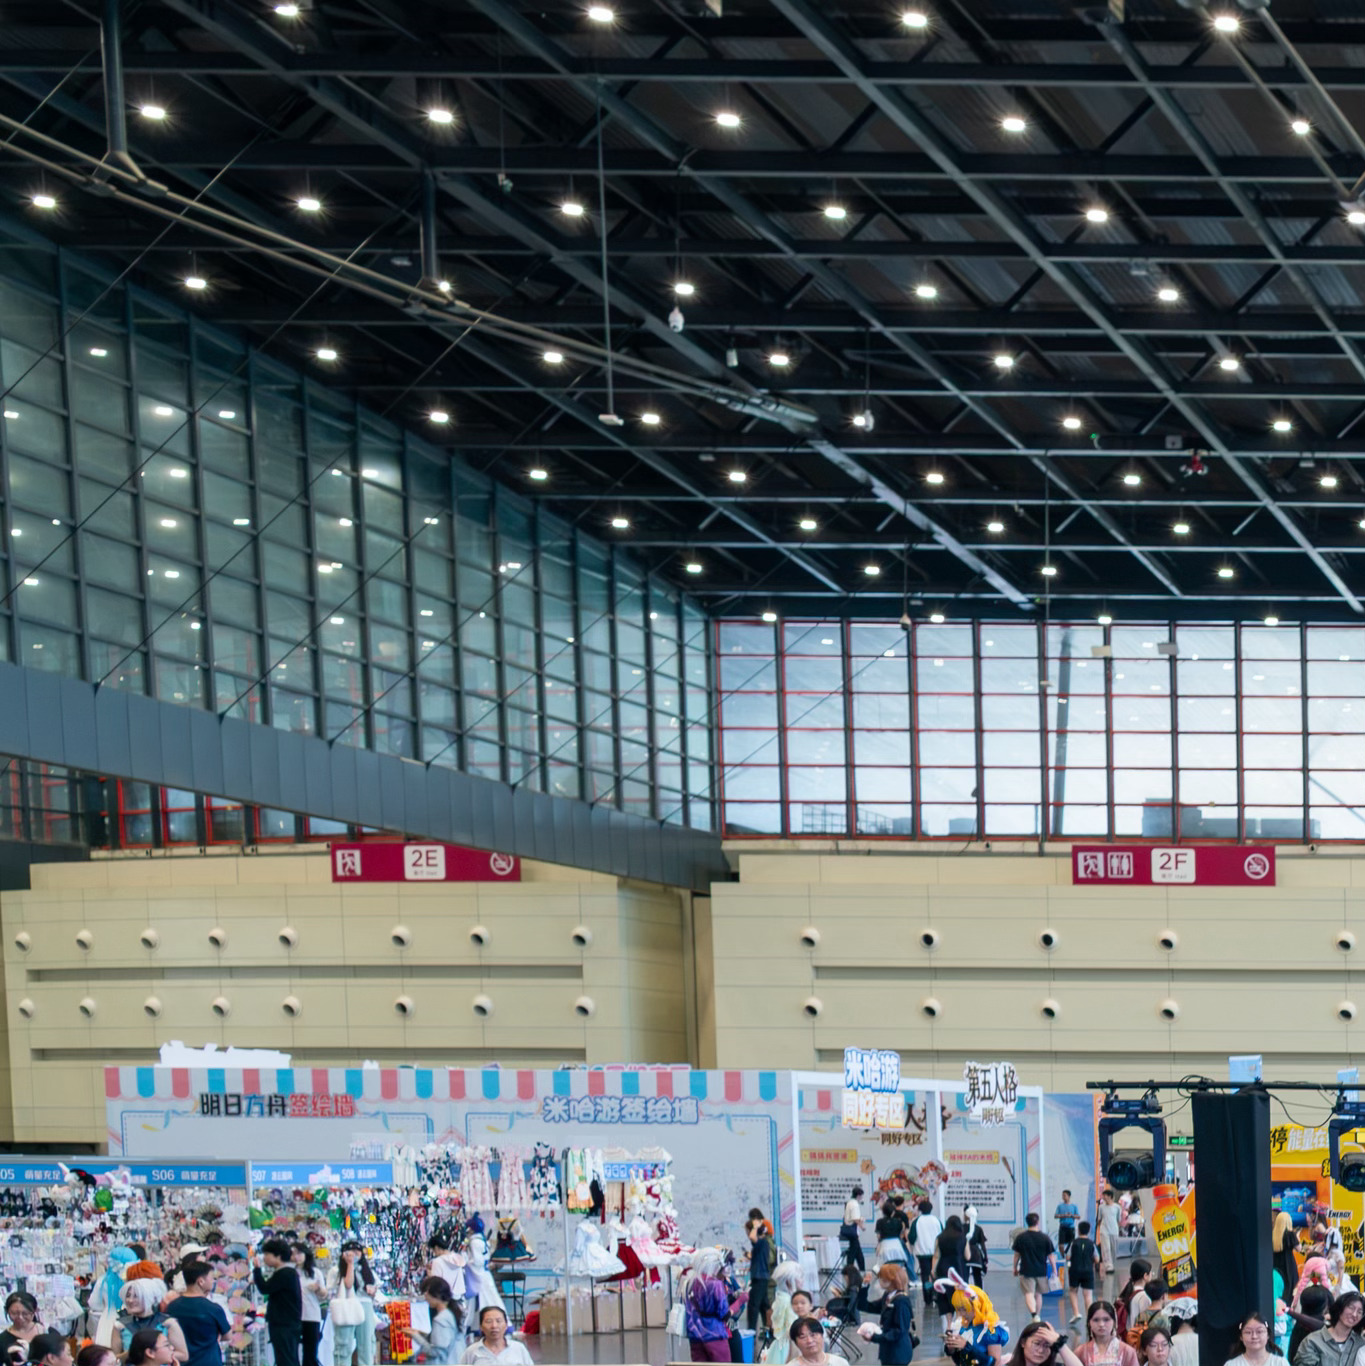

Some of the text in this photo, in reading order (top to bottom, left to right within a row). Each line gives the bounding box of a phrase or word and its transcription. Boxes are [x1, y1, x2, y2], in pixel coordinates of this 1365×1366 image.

[411, 850, 439, 867] 2E
[1159, 853, 1188, 870] 2F
[844, 1050, 900, 1093] 米哈游
[966, 1065, 1018, 1107] 第五人格
[200, 1093, 355, 1118] 明日方舟签绘墙
[544, 1096, 699, 1124] 米哈游签绘墙
[842, 1091, 905, 1128] 同好专区
[151, 1169, 175, 1181] S06
[252, 1170, 267, 1182] S07
[1156, 1222, 1185, 1242] ENERGY
[1162, 1238, 1189, 1255] ON
